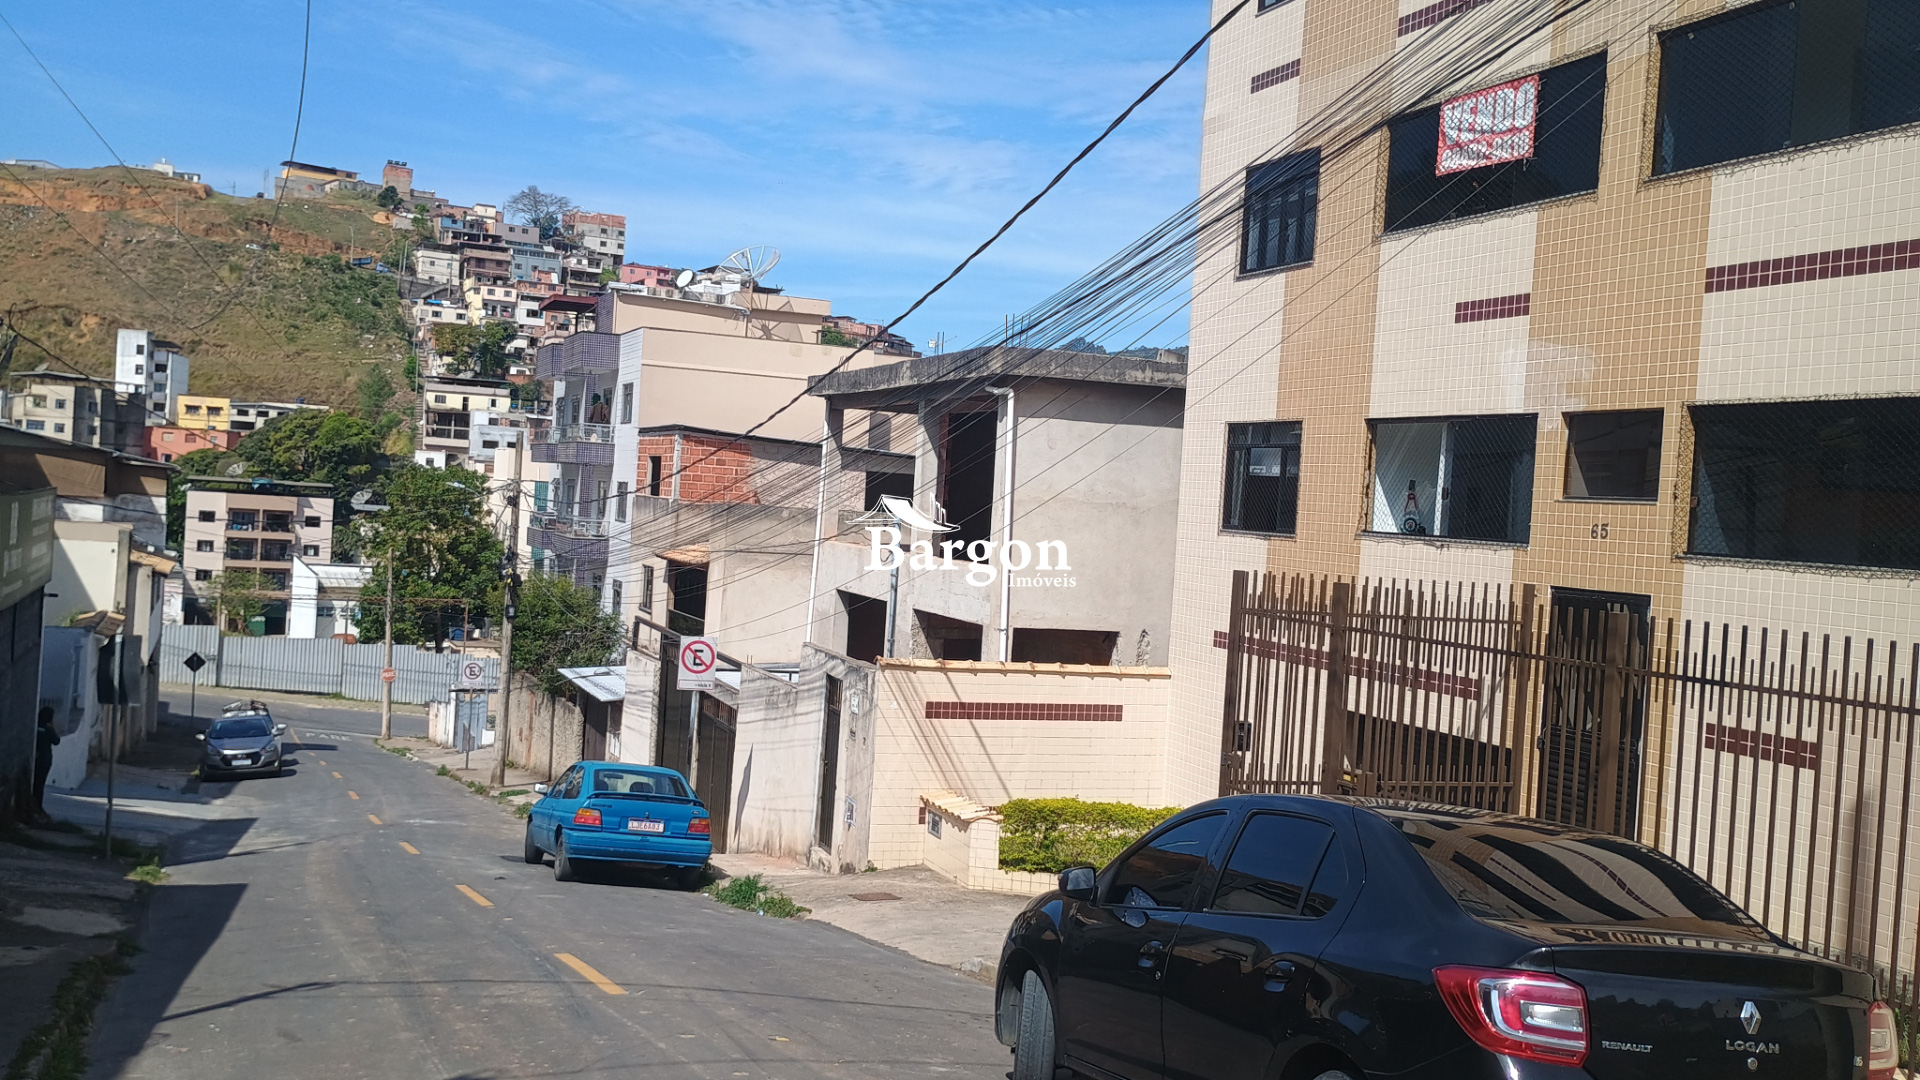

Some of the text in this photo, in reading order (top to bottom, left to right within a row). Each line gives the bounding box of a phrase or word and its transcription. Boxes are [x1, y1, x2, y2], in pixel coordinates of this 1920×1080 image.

[1444, 82, 1535, 144] VENDO
[1591, 522, 1609, 539] 65
[1601, 1040, 1653, 1053] RENAULT
[1725, 1039, 1780, 1054] LOGAN
